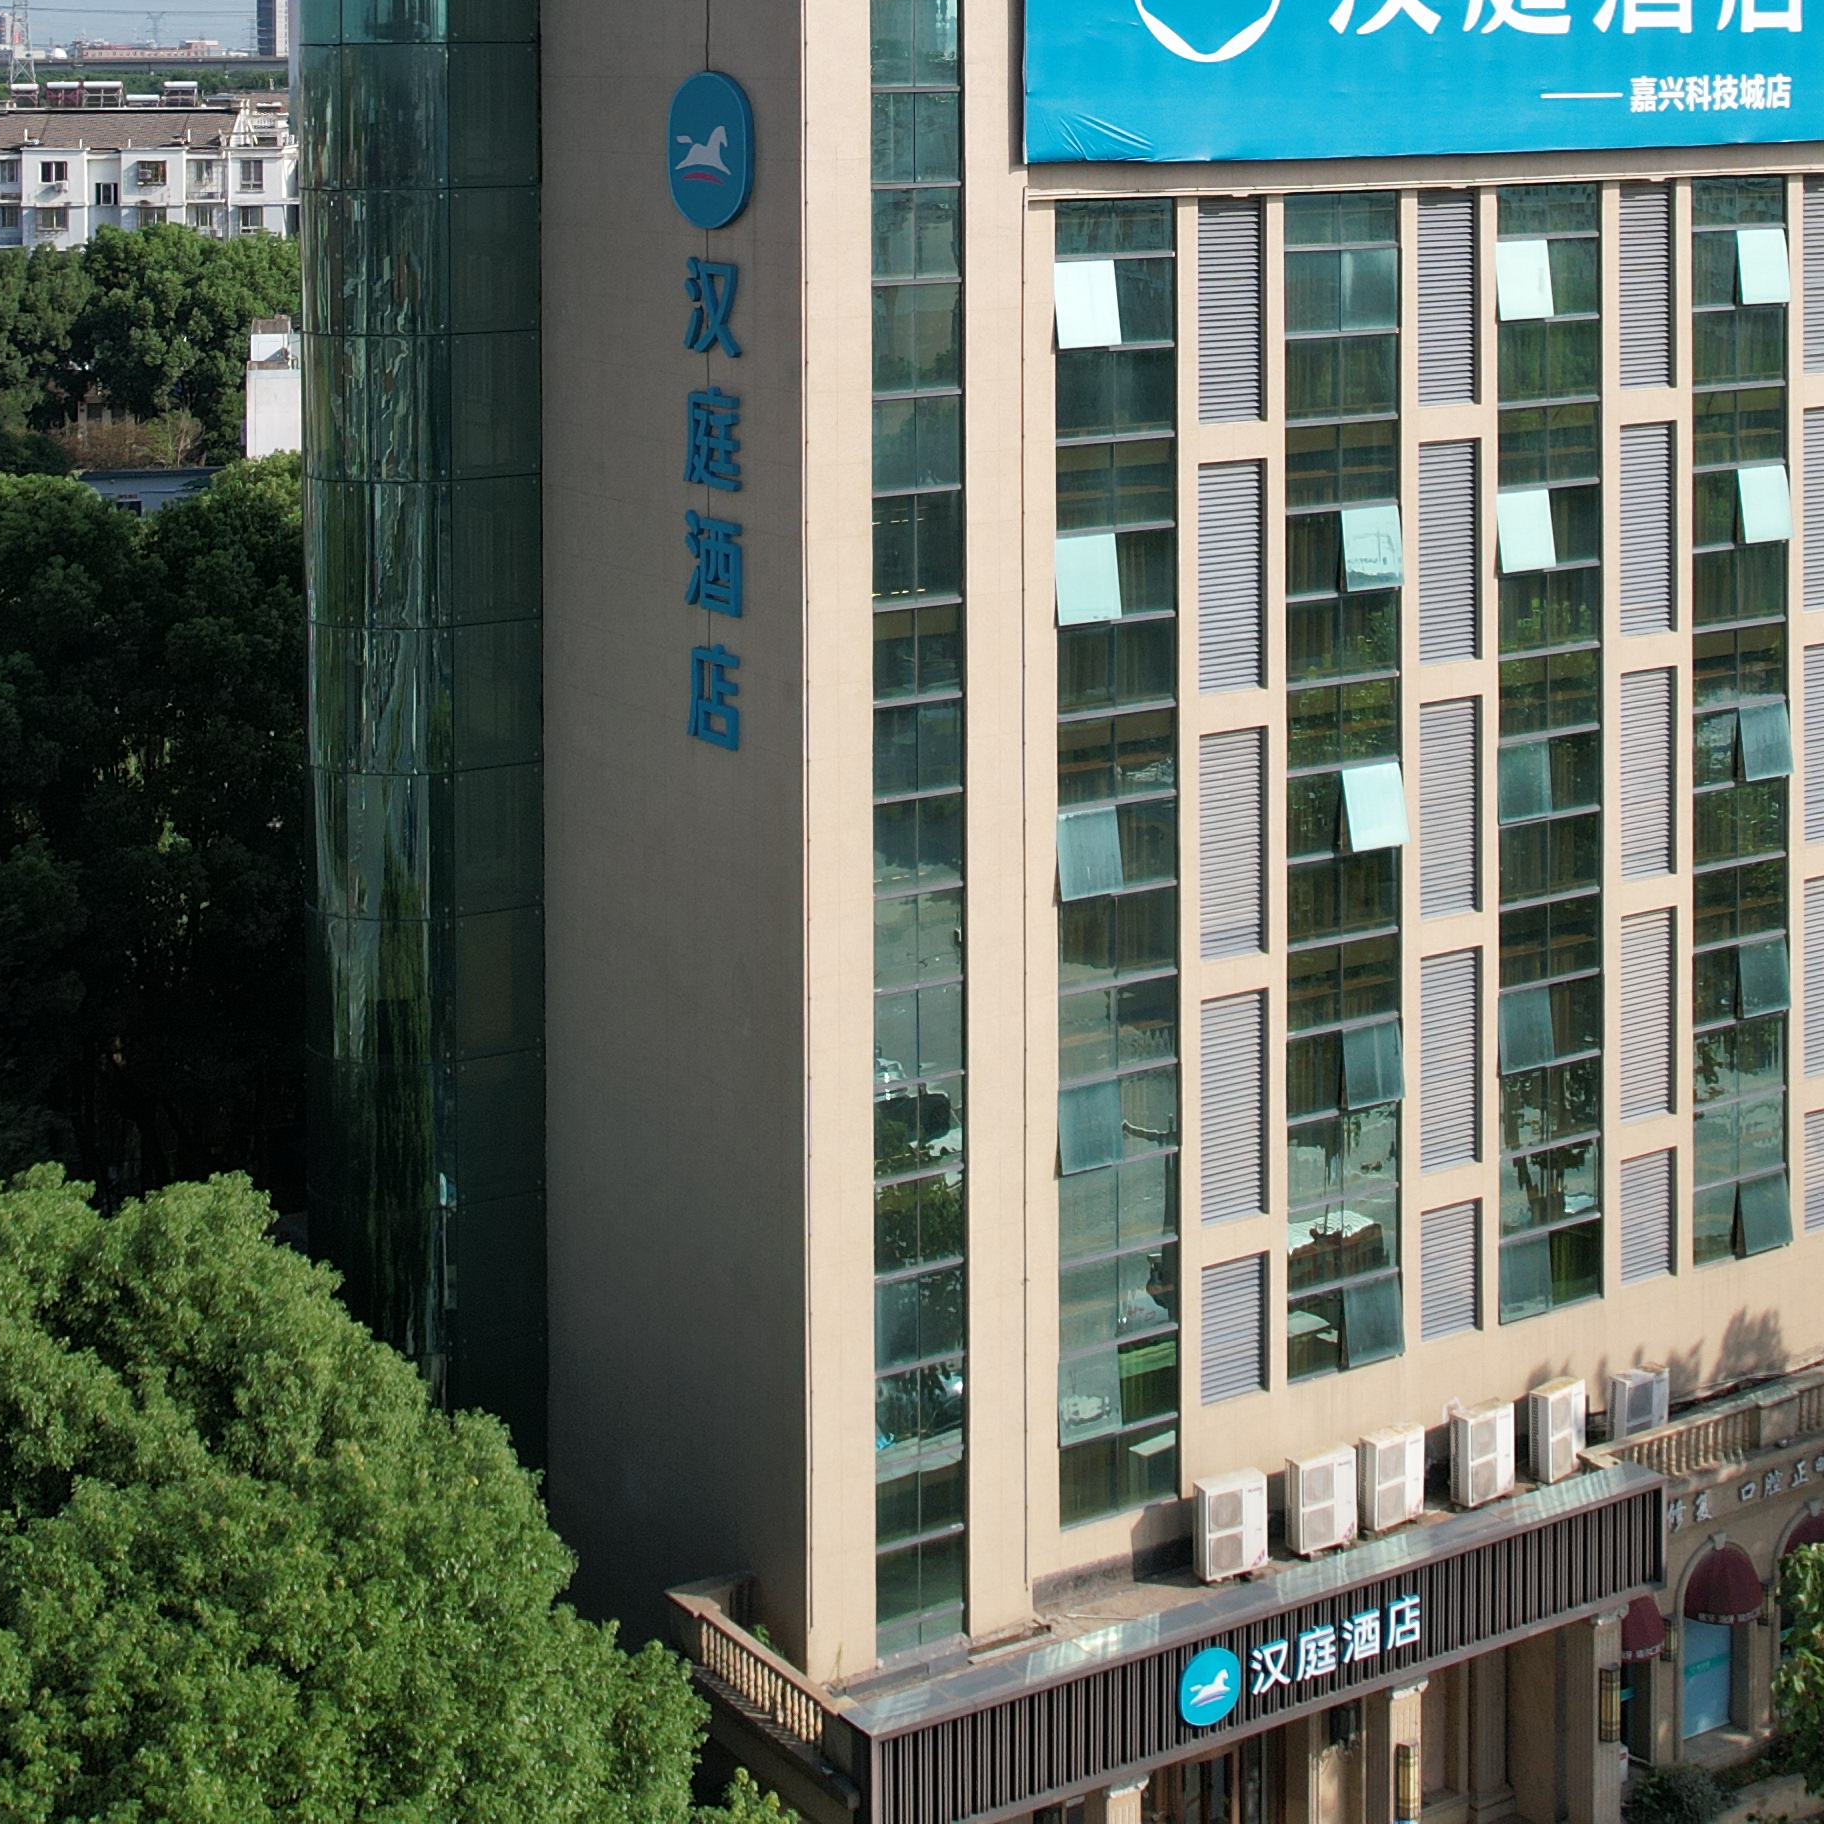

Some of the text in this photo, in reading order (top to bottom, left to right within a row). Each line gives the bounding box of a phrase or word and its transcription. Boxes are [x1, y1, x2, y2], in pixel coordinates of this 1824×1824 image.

[683, 256, 743, 752] 汉庭酒店
[1250, 1594, 1420, 1695] 汉庭酒店
